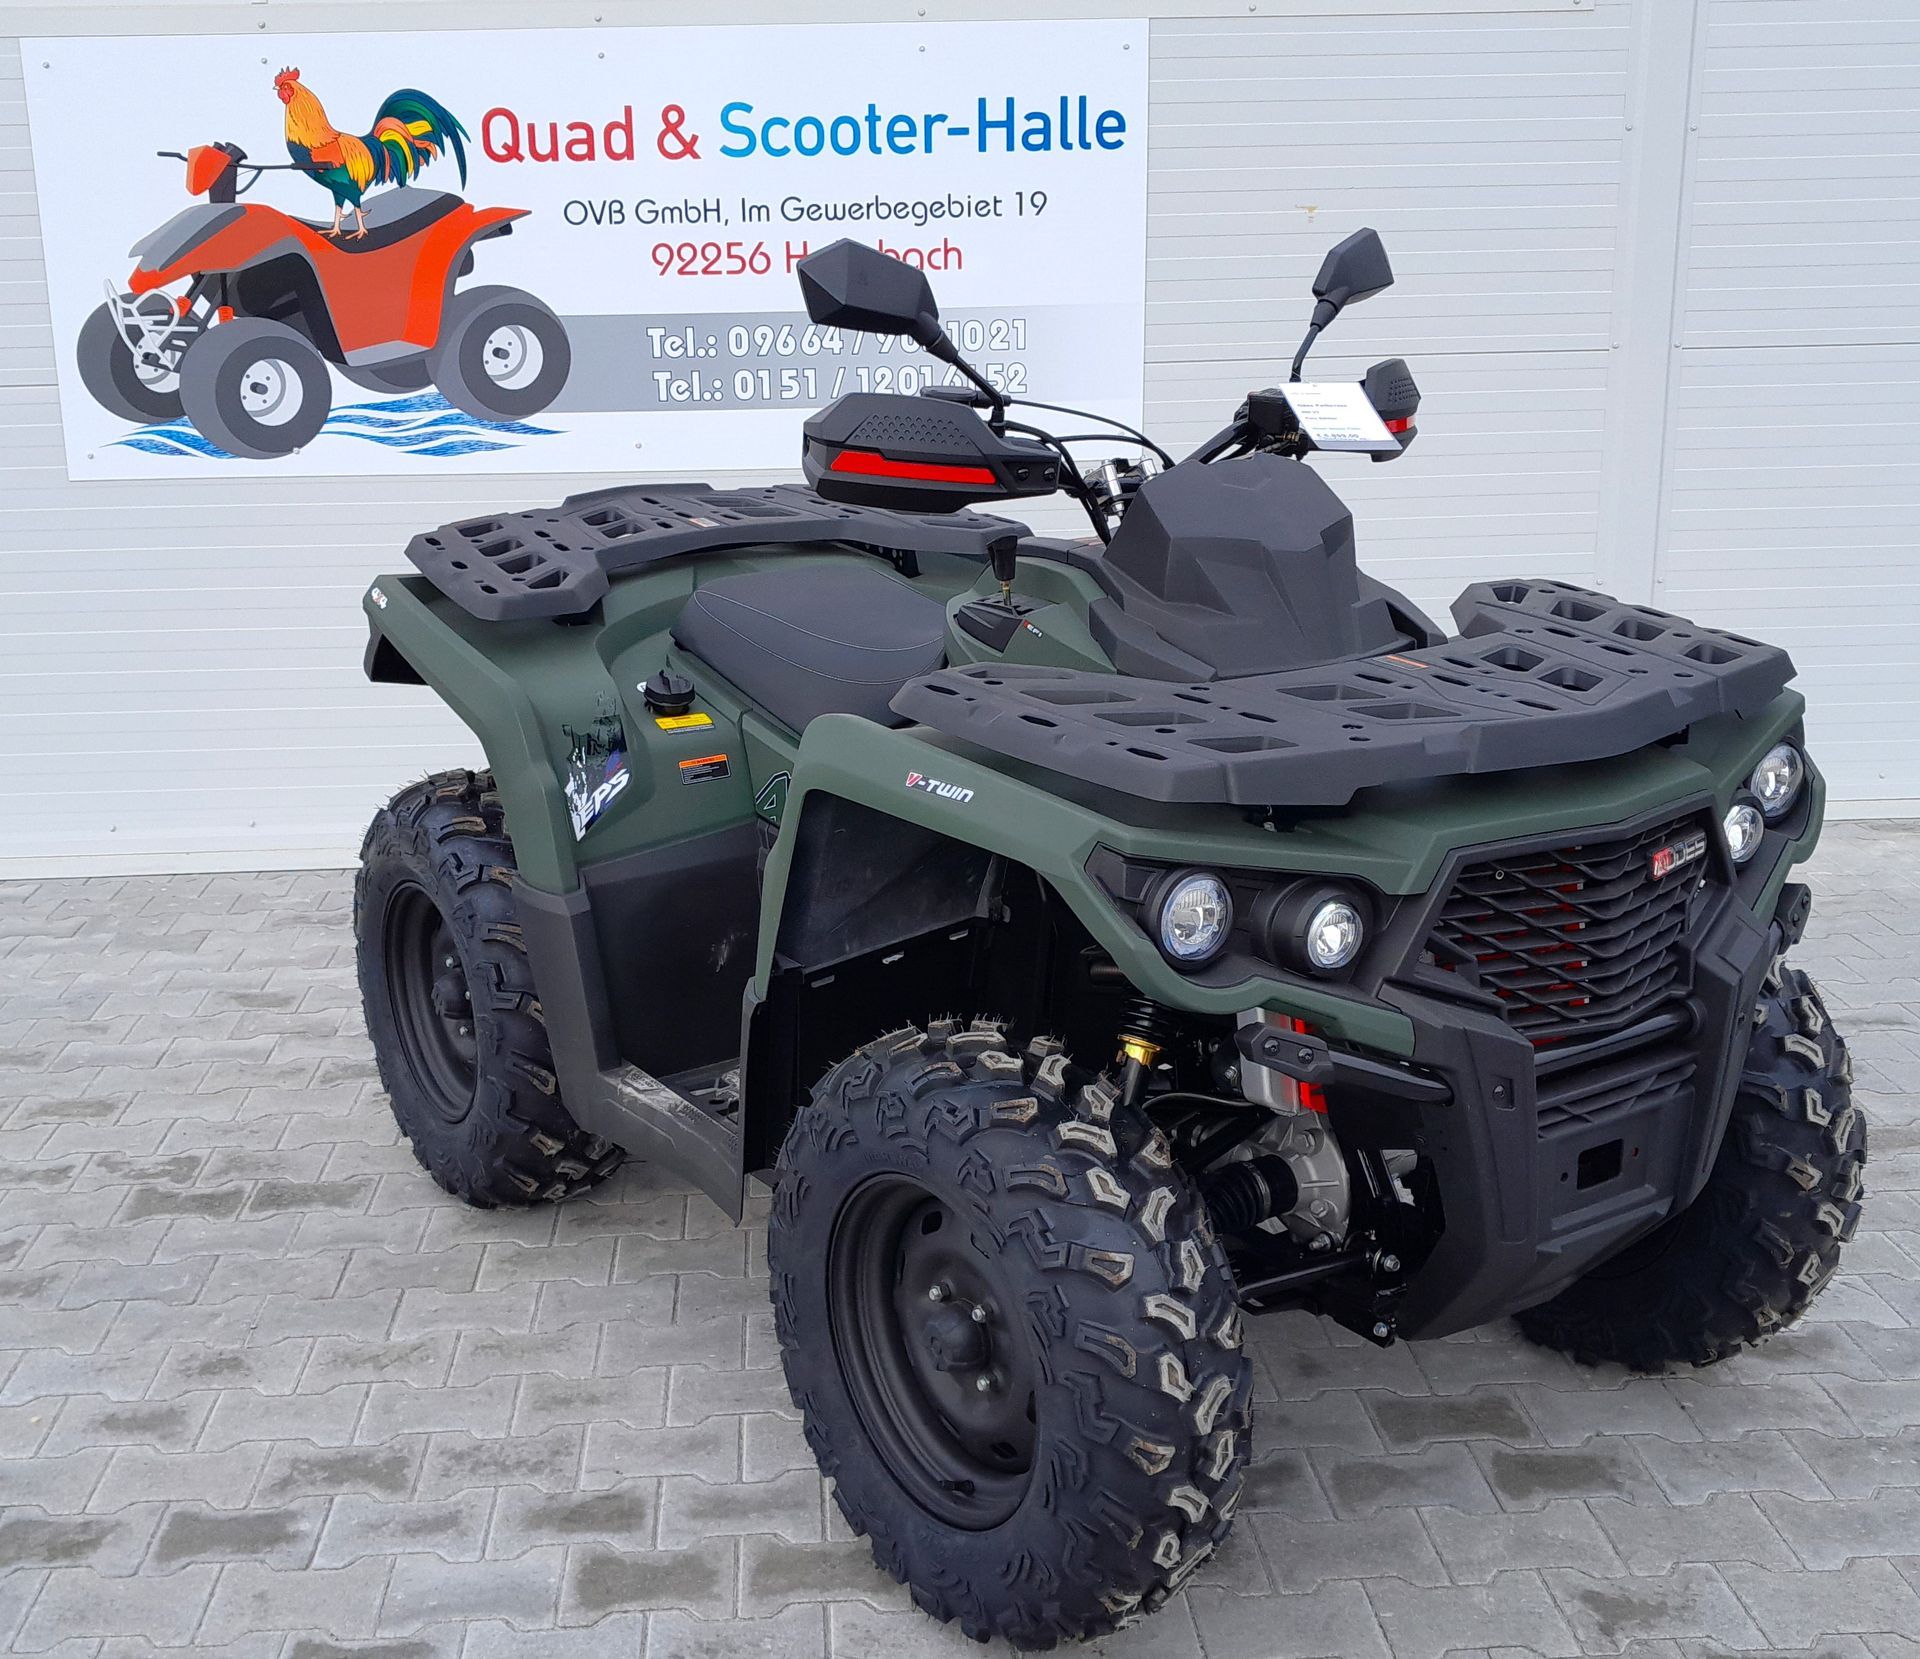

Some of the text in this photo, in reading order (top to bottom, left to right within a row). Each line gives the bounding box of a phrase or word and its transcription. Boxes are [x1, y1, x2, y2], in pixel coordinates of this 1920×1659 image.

[481, 95, 1126, 163] Quad & Scooter-Halle
[635, 198, 729, 226] GmbH,
[780, 193, 1003, 227] Gewerbegebiet
[1014, 190, 1049, 217] 19
[651, 241, 771, 276] 92256
[646, 325, 718, 358] Tel.:
[727, 323, 844, 357] 09664
[652, 369, 723, 402] Tel.:
[733, 367, 817, 400] 0151
[830, 366, 846, 399] /
[579, 768, 630, 828] EPS
